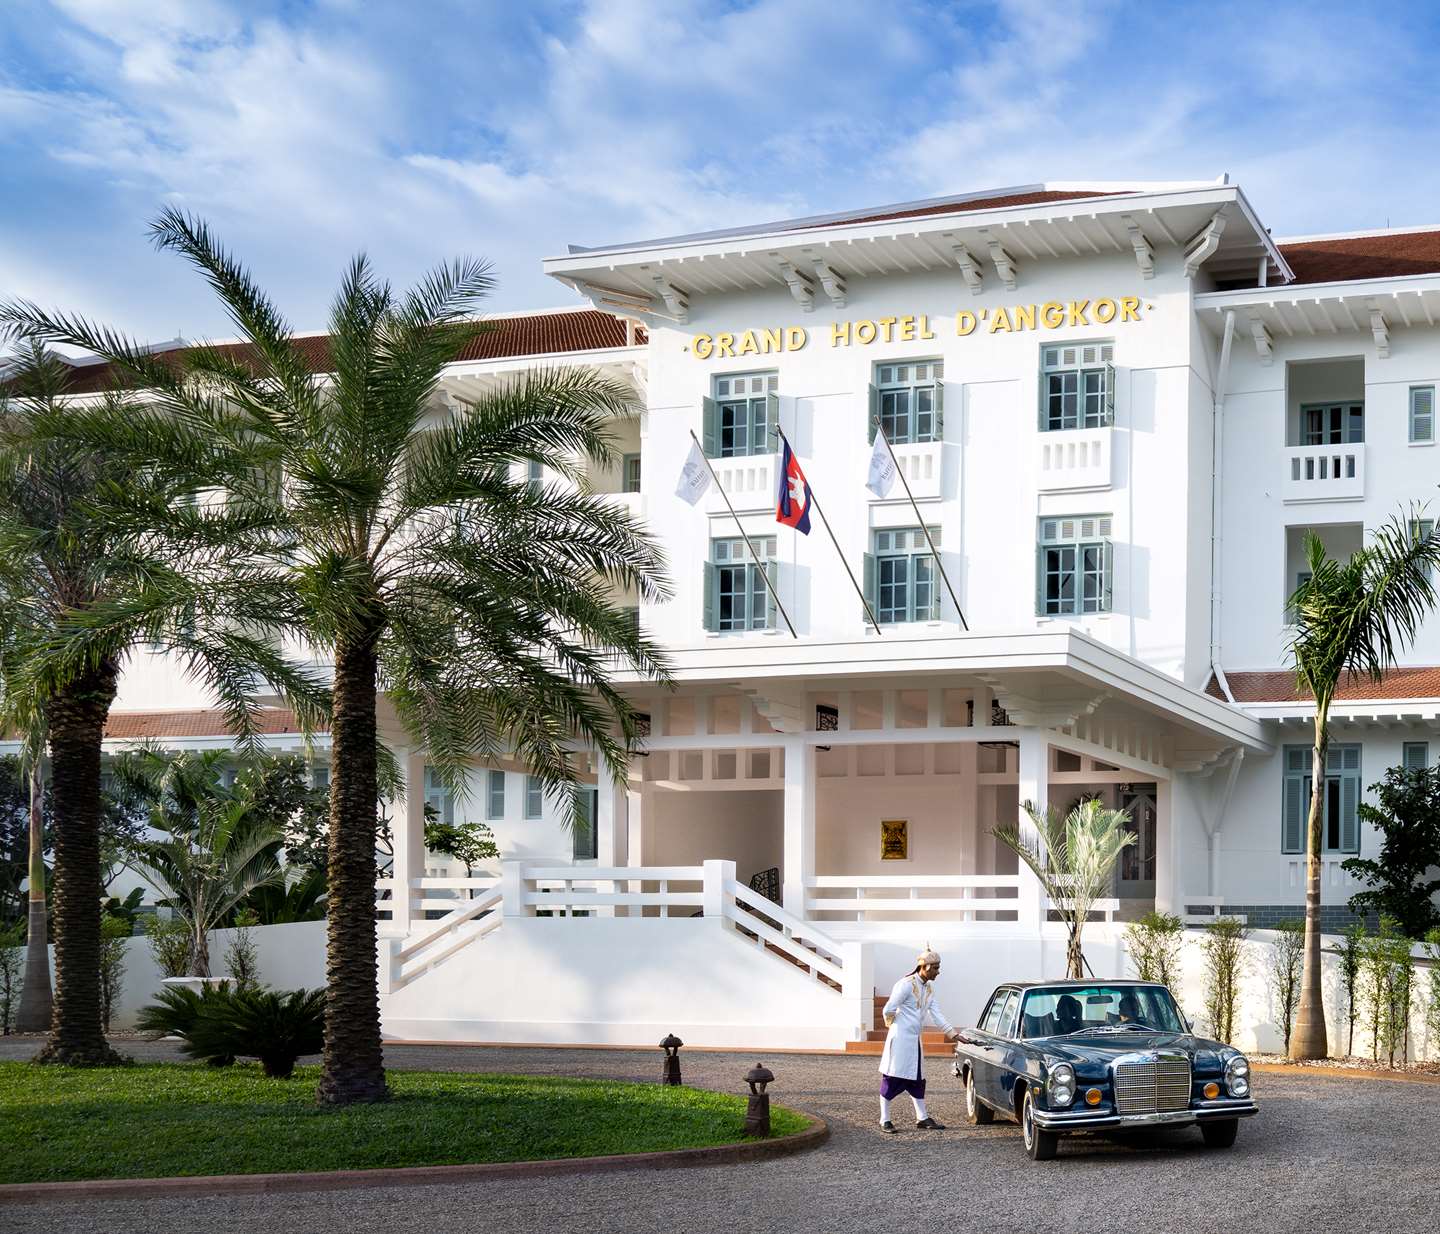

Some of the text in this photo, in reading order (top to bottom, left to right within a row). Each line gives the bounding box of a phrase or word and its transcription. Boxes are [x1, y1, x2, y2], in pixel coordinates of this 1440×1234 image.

[692, 296, 1141, 360] GRAND HOTEL D'ANGKOR
